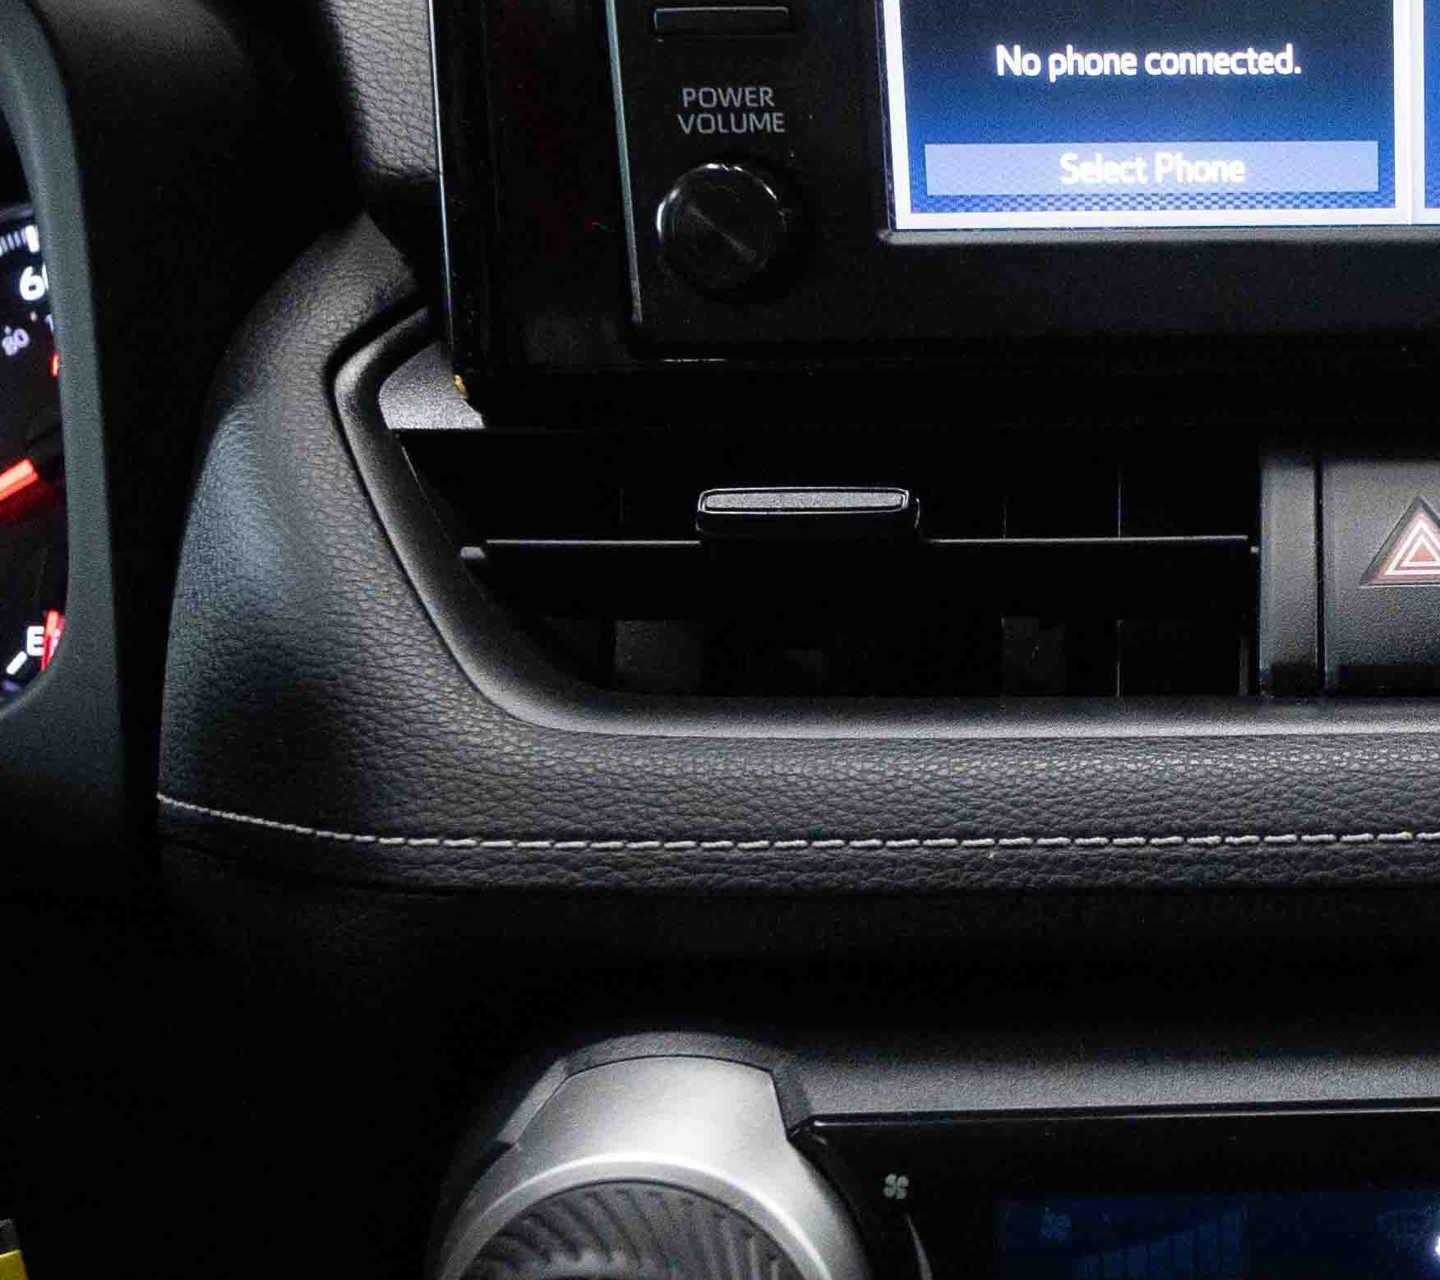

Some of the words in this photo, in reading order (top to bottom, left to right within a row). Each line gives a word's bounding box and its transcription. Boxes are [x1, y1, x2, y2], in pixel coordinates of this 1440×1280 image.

[996, 45, 1041, 76] No
[1048, 45, 1138, 82] phone
[1144, 44, 1303, 76] connected.
[682, 86, 775, 109] POWER
[677, 111, 785, 135] VOLUME
[1059, 152, 1147, 185] Select
[1155, 151, 1246, 184] Phone
[19, 262, 49, 301] 6
